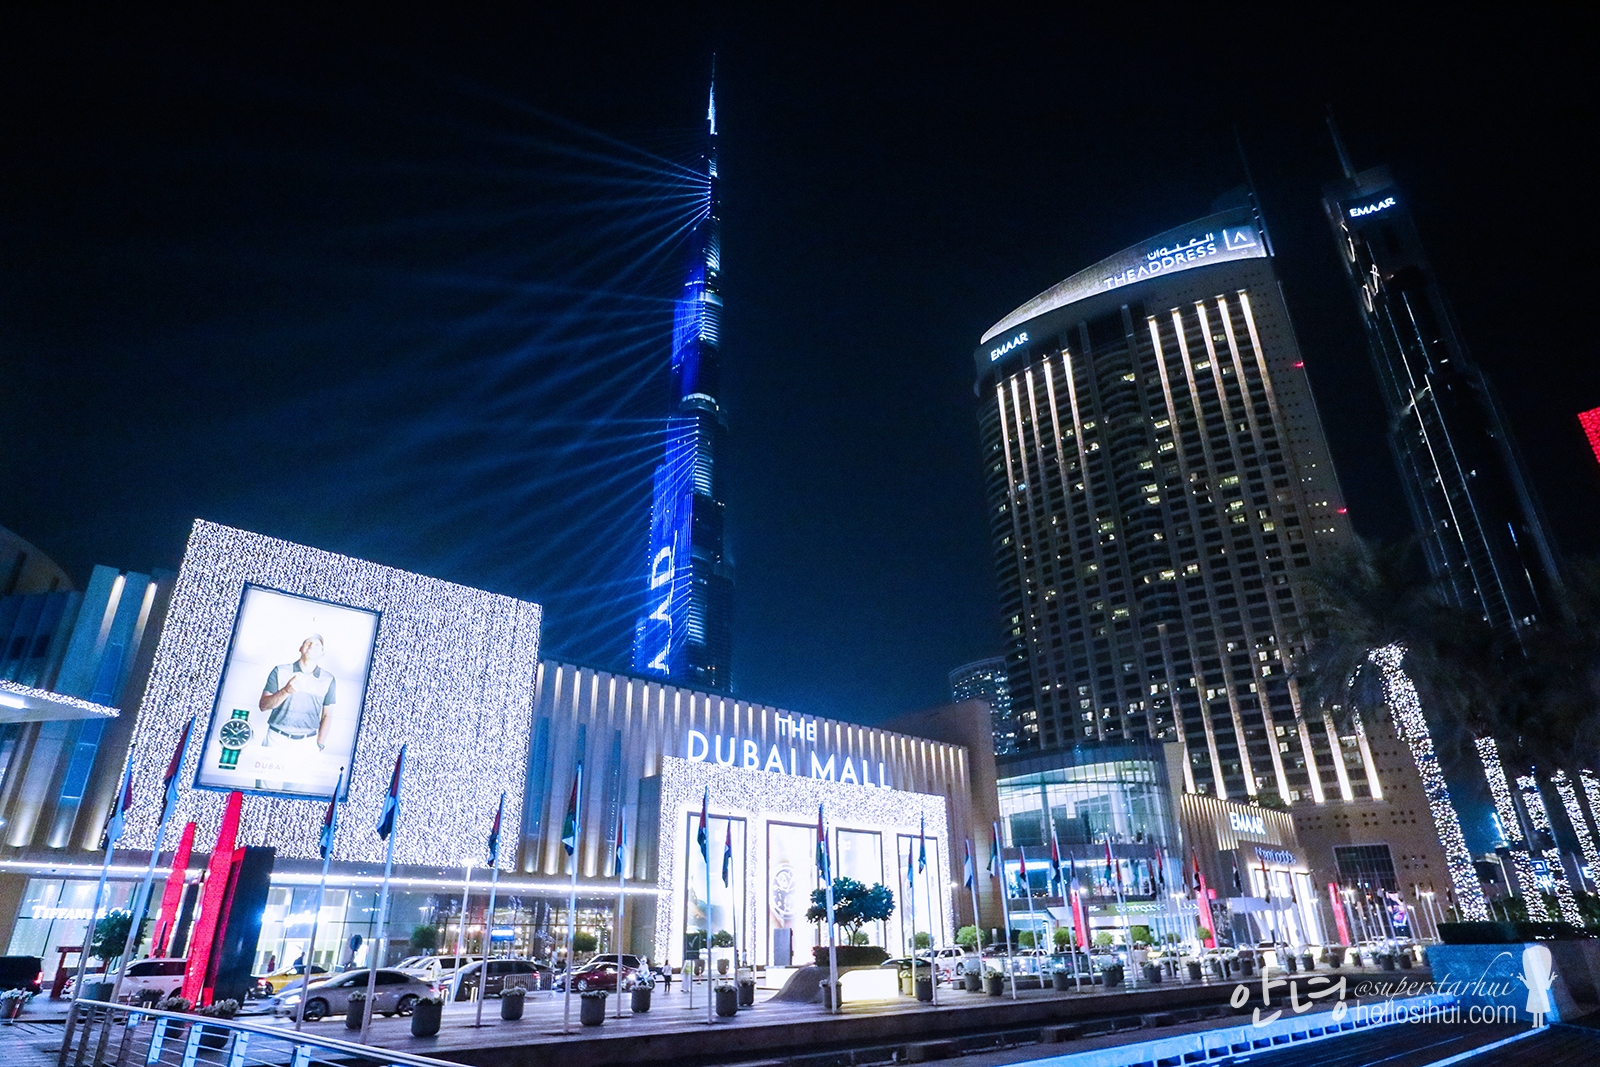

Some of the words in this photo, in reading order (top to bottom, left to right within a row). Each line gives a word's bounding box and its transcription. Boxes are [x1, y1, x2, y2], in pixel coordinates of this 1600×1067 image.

[1349, 197, 1396, 217] EMAAR
[990, 332, 1029, 362] EMAAR
[778, 717, 817, 742] THE
[254, 761, 285, 771] DUBAI
[686, 729, 797, 777] DUBAI
[811, 750, 892, 791] MALL
[1229, 811, 1266, 835] EMAAR
